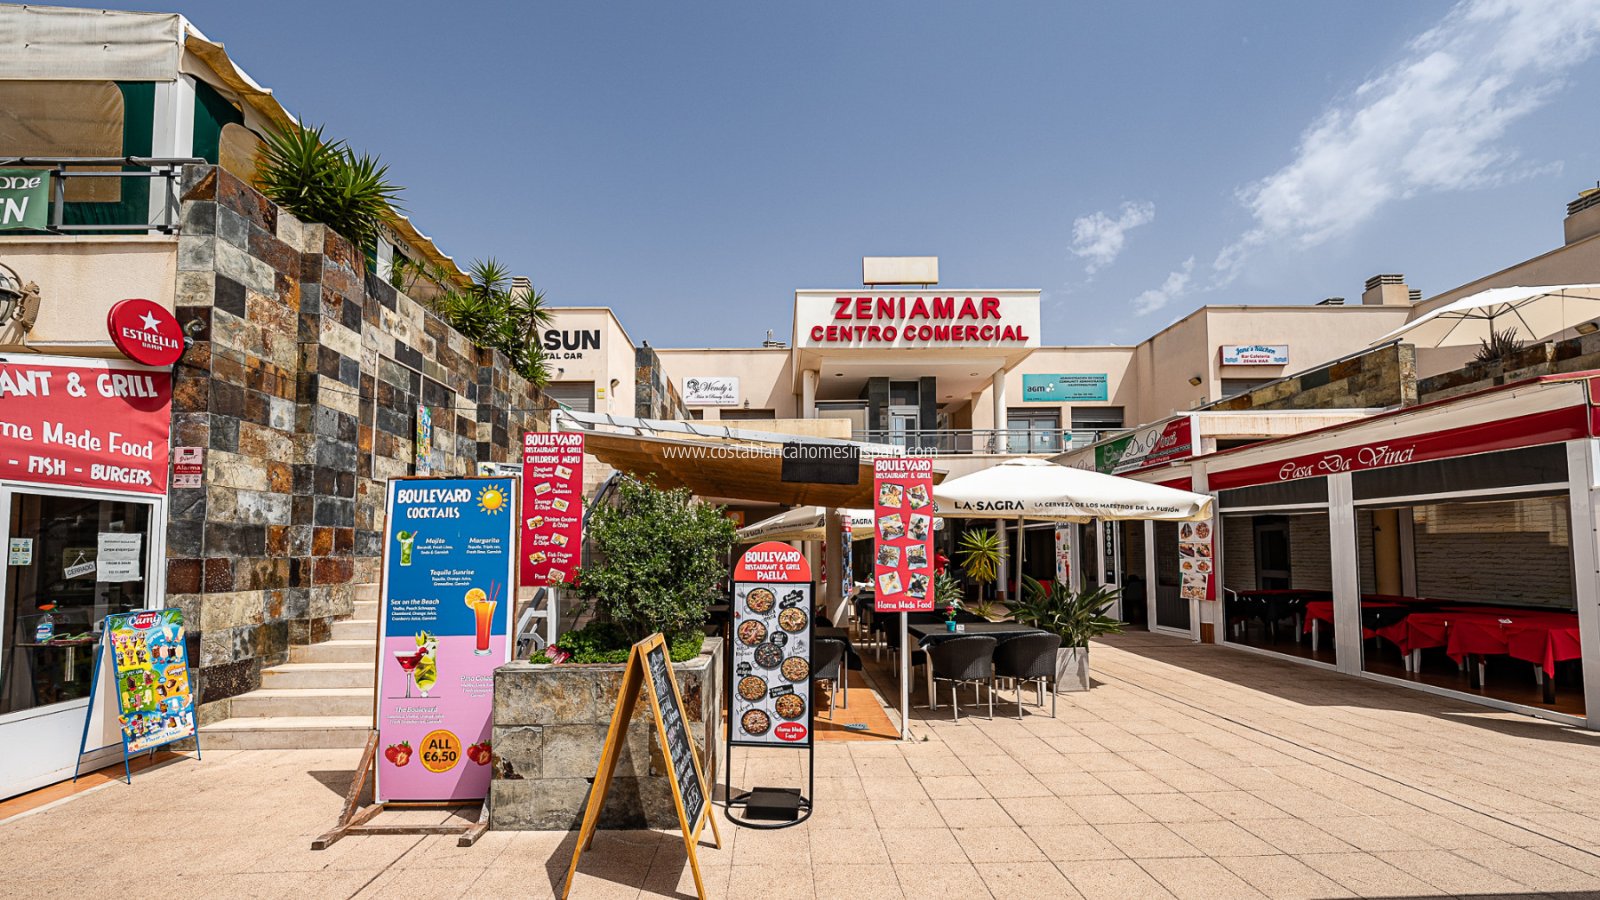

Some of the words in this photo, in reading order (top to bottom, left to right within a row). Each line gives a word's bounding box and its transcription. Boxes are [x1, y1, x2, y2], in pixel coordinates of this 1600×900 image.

[835, 297, 1002, 319] ZENIAMAR
[122, 326, 179, 350] ESTRELLA
[811, 325, 897, 341] CENTRO
[903, 325, 1029, 341] COMERCIAL
[563, 352, 583, 360] CAR
[66, 371, 88, 398] &
[96, 373, 159, 398] GRILL
[700, 380, 733, 395] Wendy's
[42, 420, 102, 452] Made
[109, 431, 153, 460] Food
[525, 434, 582, 446] BOULEVARD
[526, 455, 560, 464] CHILDRENS
[561, 455, 580, 464] MENU
[875, 460, 931, 471] BOULEVARD
[1278, 462, 1315, 481] Casa
[1317, 454, 1353, 473] Da
[1357, 444, 1416, 466] Vinci
[27, 455, 66, 476] FISH
[90, 463, 153, 487] BURGERS
[397, 488, 472, 504] BOULEVARD
[1100, 502, 1134, 510] MAESTROS
[406, 507, 460, 519] COCKTAILS
[745, 551, 800, 563] BOULEVARD
[66, 563, 93, 576] CERRADO
[756, 571, 788, 581] PAELLA
[877, 600, 897, 609] Home
[898, 600, 915, 609] Made
[916, 600, 932, 609] Food
[127, 613, 162, 627] Camy
[429, 739, 452, 750] ALL
[423, 751, 457, 764] €6,50
